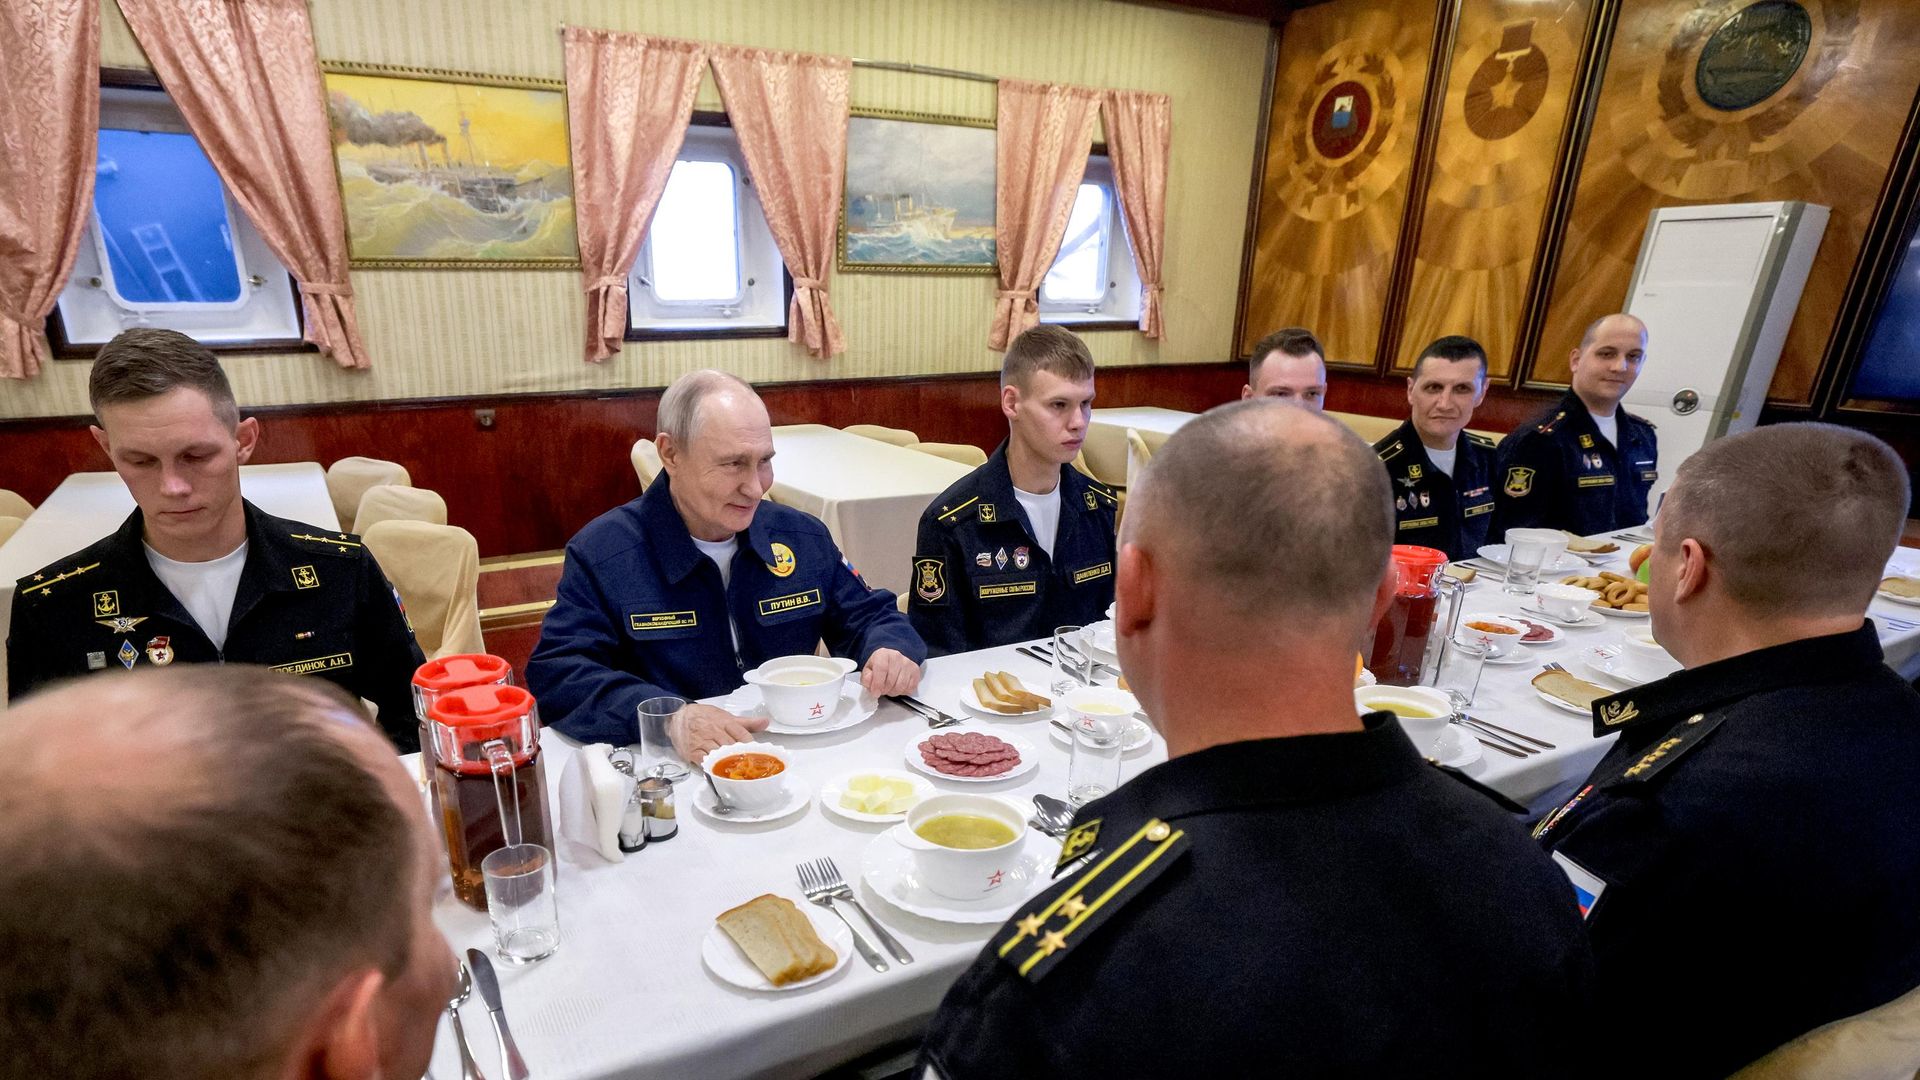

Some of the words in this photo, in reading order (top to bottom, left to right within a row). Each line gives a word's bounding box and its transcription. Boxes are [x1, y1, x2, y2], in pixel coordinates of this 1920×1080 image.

[770, 599, 796, 610] ПУТИН
[796, 595, 811, 605] В.В.
[330, 657, 346, 666] А.Н.
